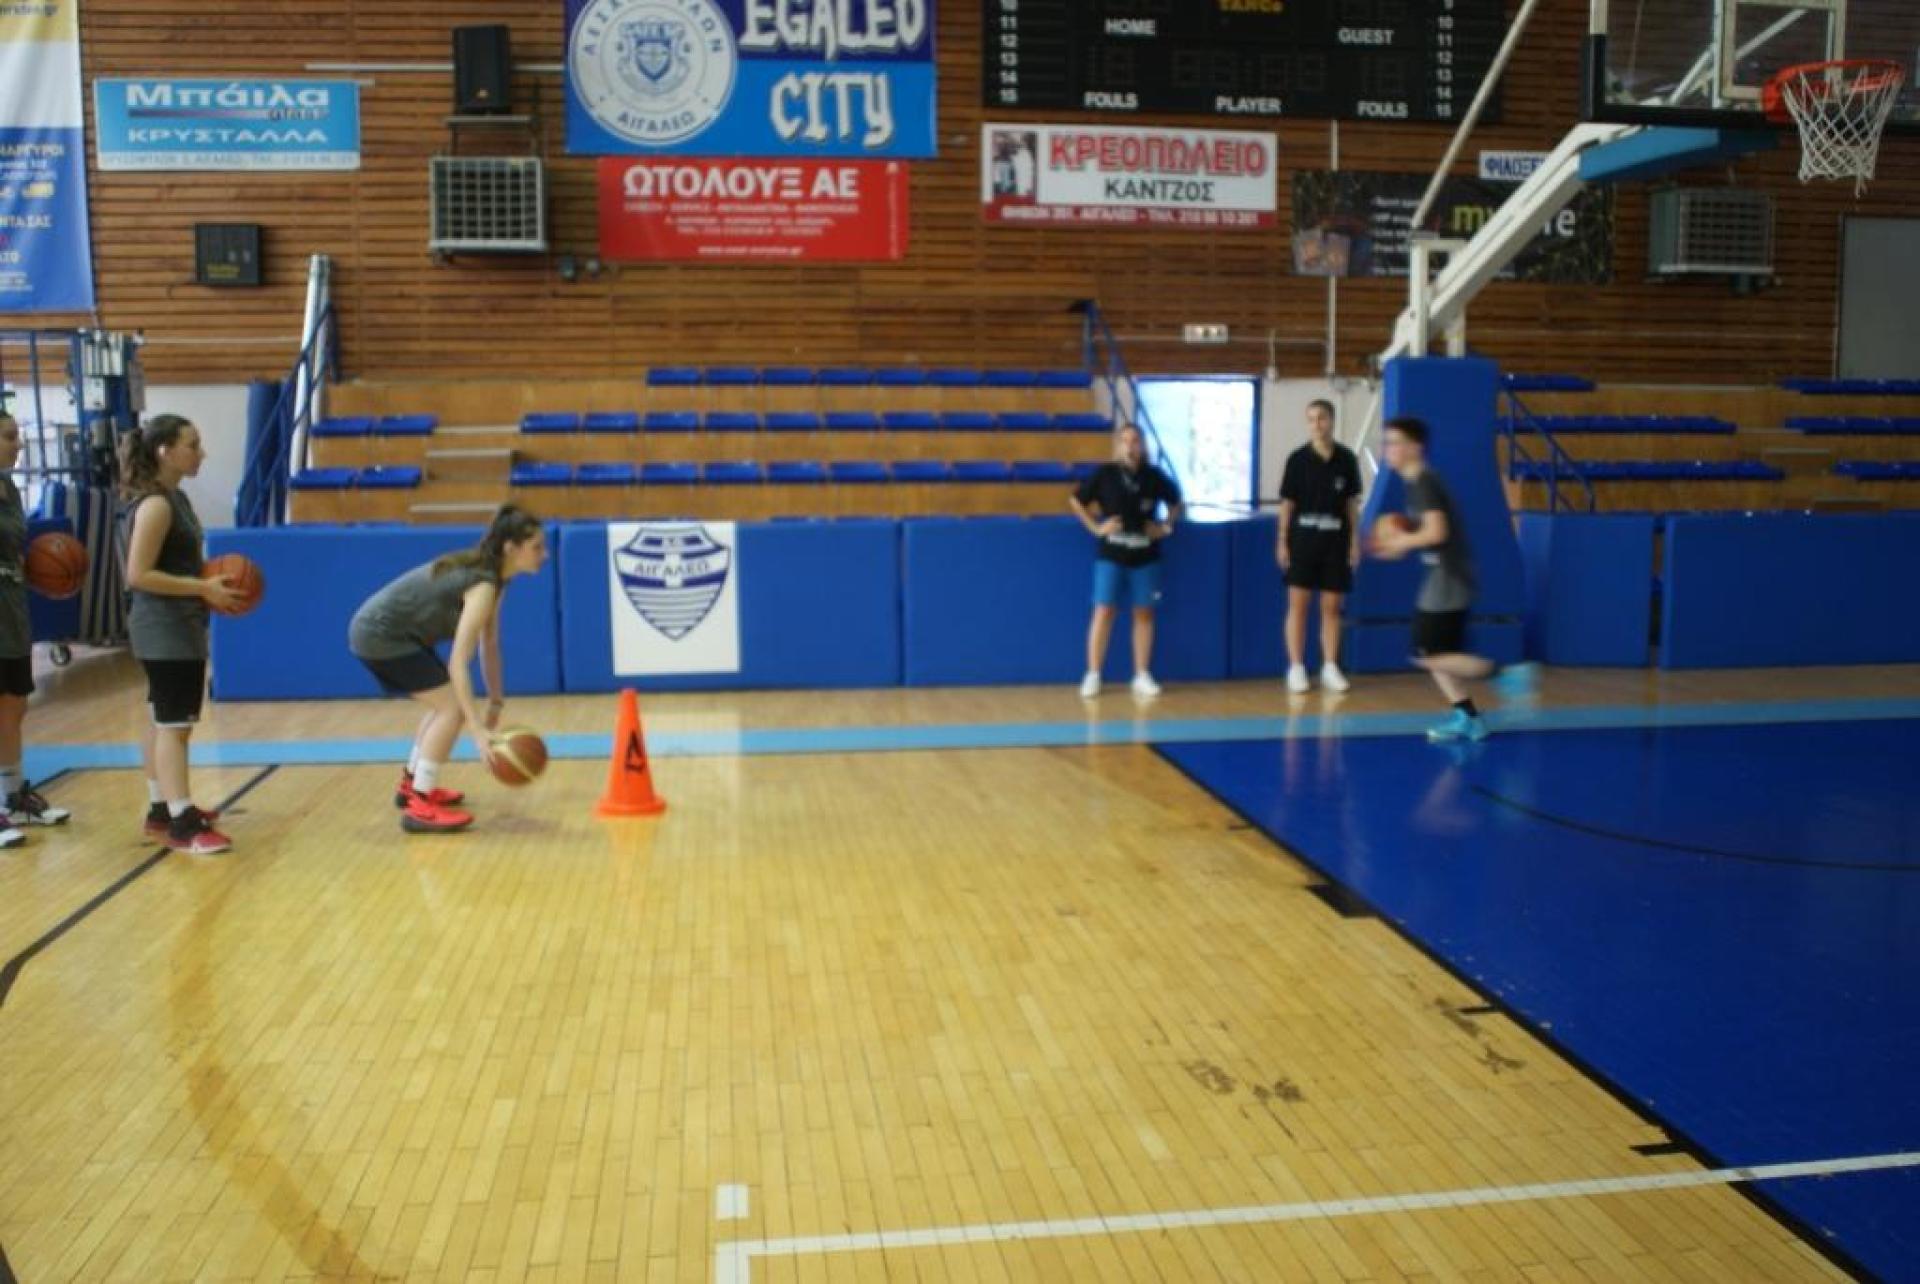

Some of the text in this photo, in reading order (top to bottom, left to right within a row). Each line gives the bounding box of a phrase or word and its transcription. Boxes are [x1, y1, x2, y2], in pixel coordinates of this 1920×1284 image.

[999, 15, 1018, 29] 11
[1104, 18, 1156, 36] HOME
[1437, 15, 1454, 29] 10
[738, 0, 926, 62] EGALEO
[1337, 27, 1395, 45] GUEST
[999, 33, 1018, 48] 12
[1437, 33, 1453, 46] 11
[999, 51, 1018, 66] 13
[1436, 50, 1453, 64] 12
[999, 69, 1018, 85] 14
[1436, 68, 1453, 82] 13
[126, 82, 329, 107] Μπάιλα
[999, 87, 1018, 102] 15
[1083, 91, 1138, 109] FOULS
[1436, 86, 1452, 99] 14
[1214, 95, 1282, 114] PLAYER
[1357, 100, 1409, 119] FOULS
[1436, 103, 1452, 117] 15
[127, 128, 328, 144] ΚΡΥΣΤΑΛΛΑ
[1050, 133, 1268, 176] ΚΡΕΟΠΩΛΕΙΟ
[623, 165, 860, 198] ΩΤΟΛΟΥΞ ΑΕ
[1104, 179, 1215, 202] ΚΑΝΤΖΟΣ
